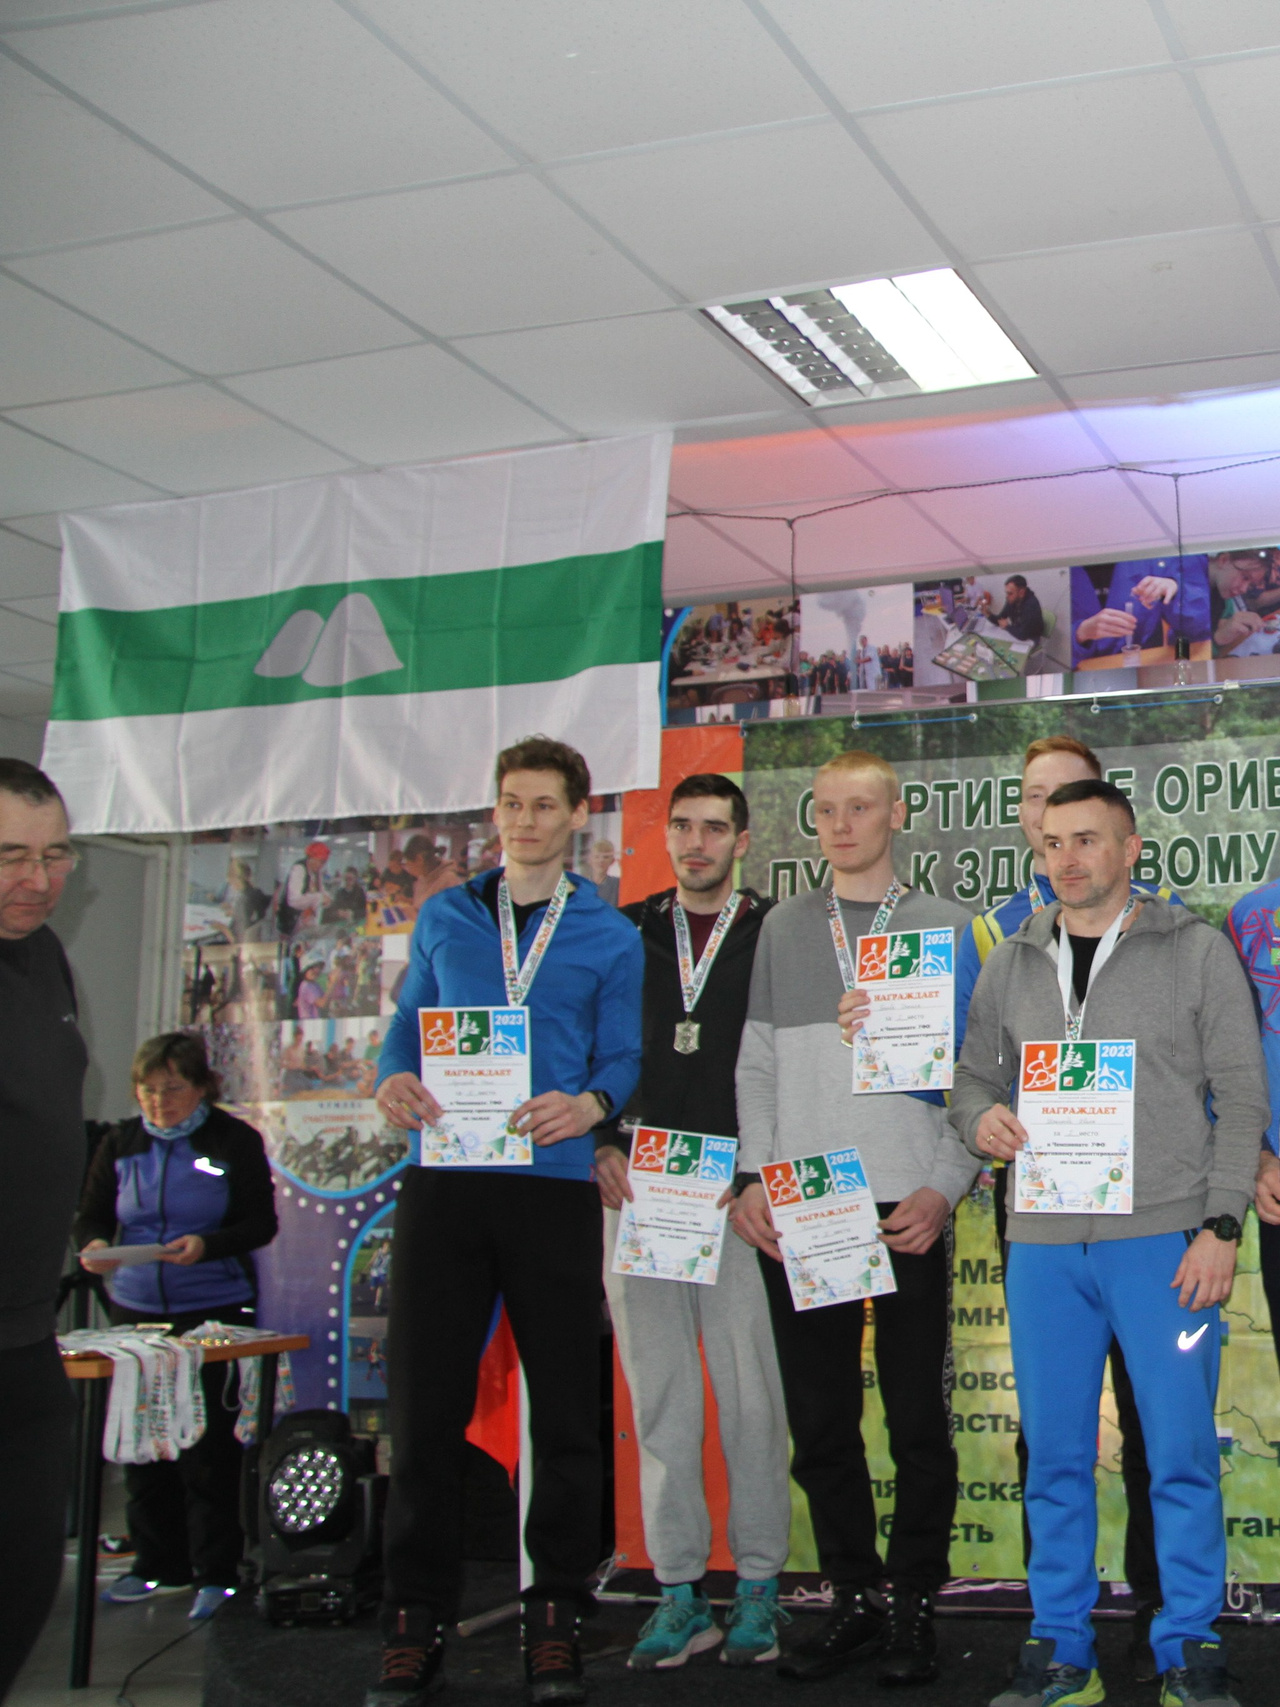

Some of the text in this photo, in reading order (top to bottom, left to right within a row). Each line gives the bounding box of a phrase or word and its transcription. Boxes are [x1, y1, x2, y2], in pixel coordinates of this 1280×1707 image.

[925, 932, 951, 945] 2023
[874, 991, 940, 1002] НАГРАЖДАЕТ
[495, 1014, 524, 1026] 2023
[1101, 1045, 1133, 1058] 2023
[444, 1069, 512, 1077] НАГРАЖДАЕТ
[1042, 1107, 1117, 1115] НАГРАЖДАЕТ
[706, 1140, 735, 1153] 2023
[830, 1151, 859, 1165] 2023
[648, 1185, 716, 1200] НАГРАЖДАЕТ
[795, 1204, 861, 1224] НАГРАЖДАЕТ
